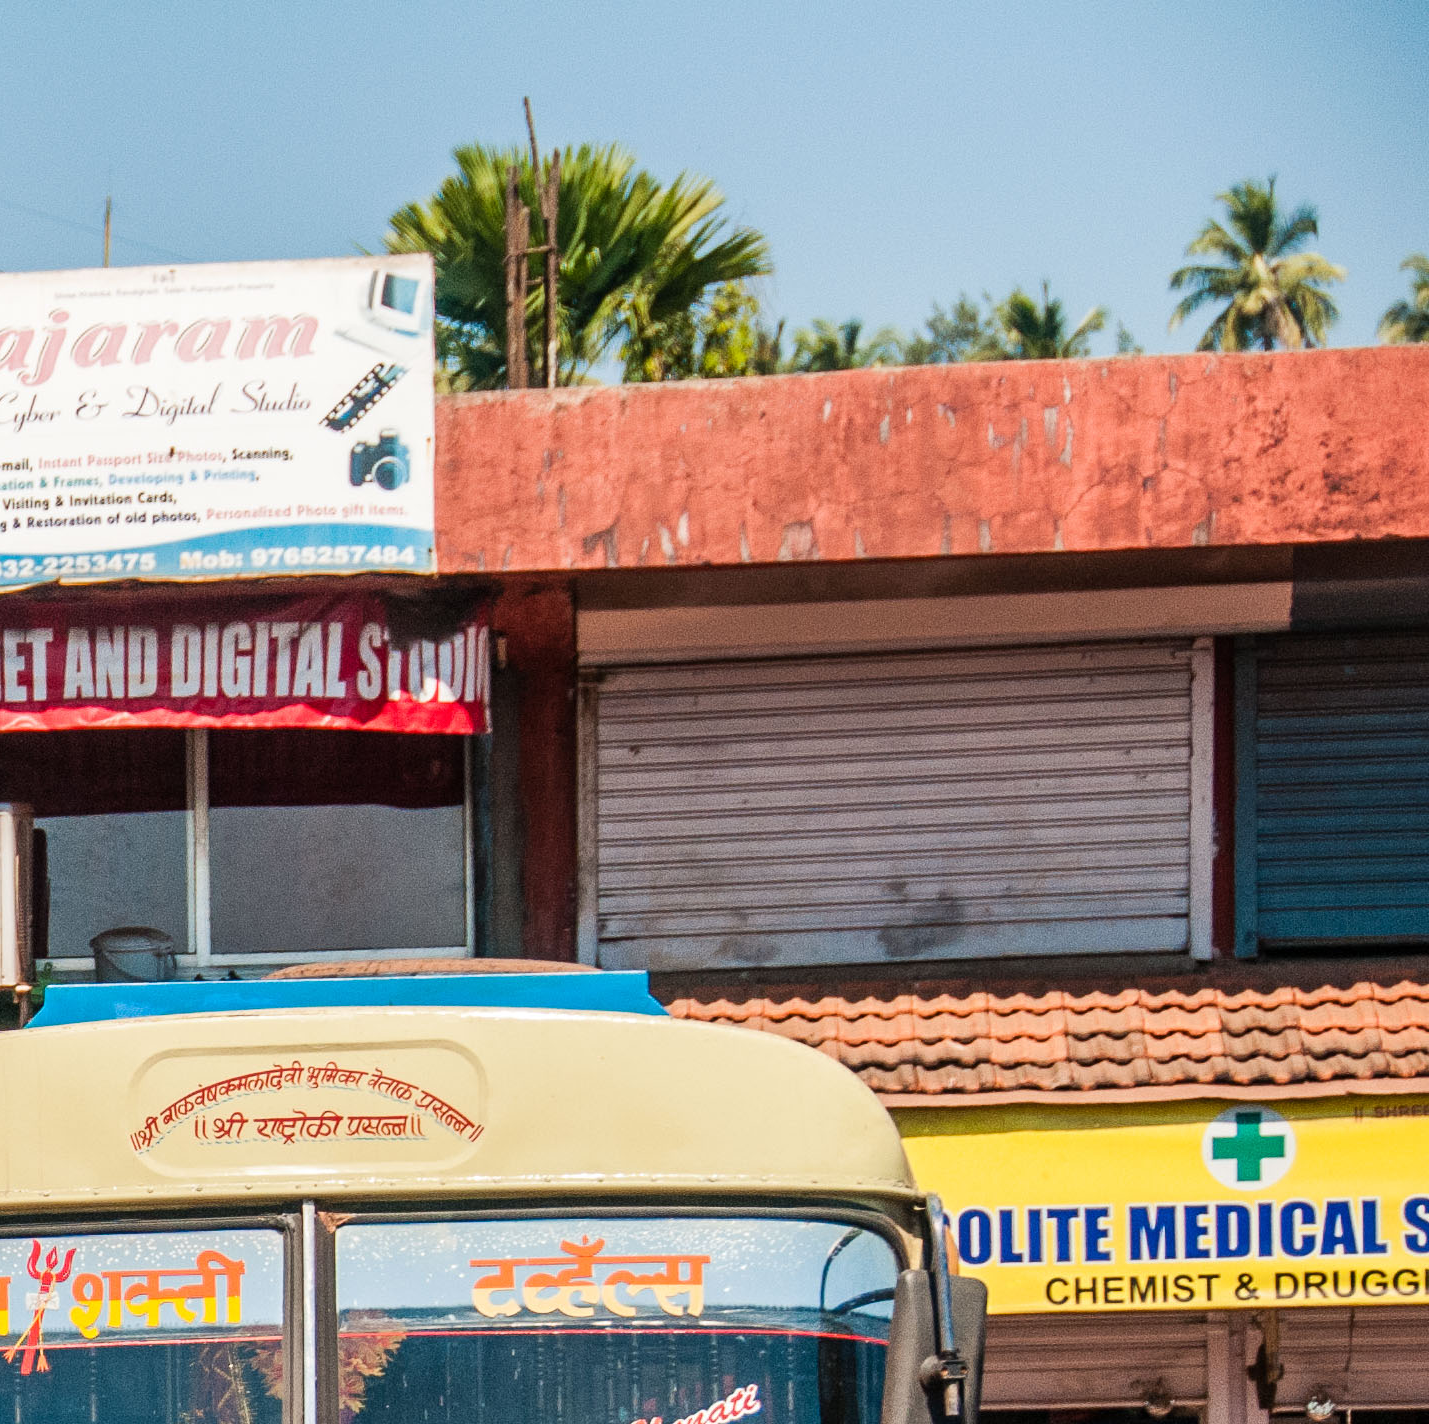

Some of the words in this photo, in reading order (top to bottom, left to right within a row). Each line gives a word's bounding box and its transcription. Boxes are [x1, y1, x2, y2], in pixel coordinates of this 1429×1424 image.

[124, 381, 221, 425] Digital
[229, 379, 313, 414] Studio
[38, 456, 84, 470] Instant
[87, 454, 142, 469] Passport
[231, 447, 294, 462] Scanning,
[39, 475, 48, 489] &
[52, 474, 104, 489] Frames,
[108, 471, 185, 488] Developing
[203, 468, 260, 482] Printing,
[2, 497, 51, 512] Visiting
[55, 494, 65, 508] &
[69, 492, 133, 507] Invitation
[137, 490, 178, 506] Cards,
[12, 517, 22, 530] &
[27, 513, 102, 529] Restoration
[107, 511, 121, 526] of
[125, 510, 147, 525] old
[151, 510, 201, 527] photos,
[297, 503, 337, 518] Photo
[342, 503, 366, 519] gift
[178, 549, 245, 571] Mob:
[250, 543, 416, 569] 9765257484
[62, 624, 159, 701] AND
[169, 620, 348, 701] DIGITAL
[942, 1203, 1113, 1267] OLITE
[1126, 1197, 1390, 1263] MEDICAL
[1044, 1272, 1221, 1306] CHEMIST
[1233, 1271, 1260, 1301] &
